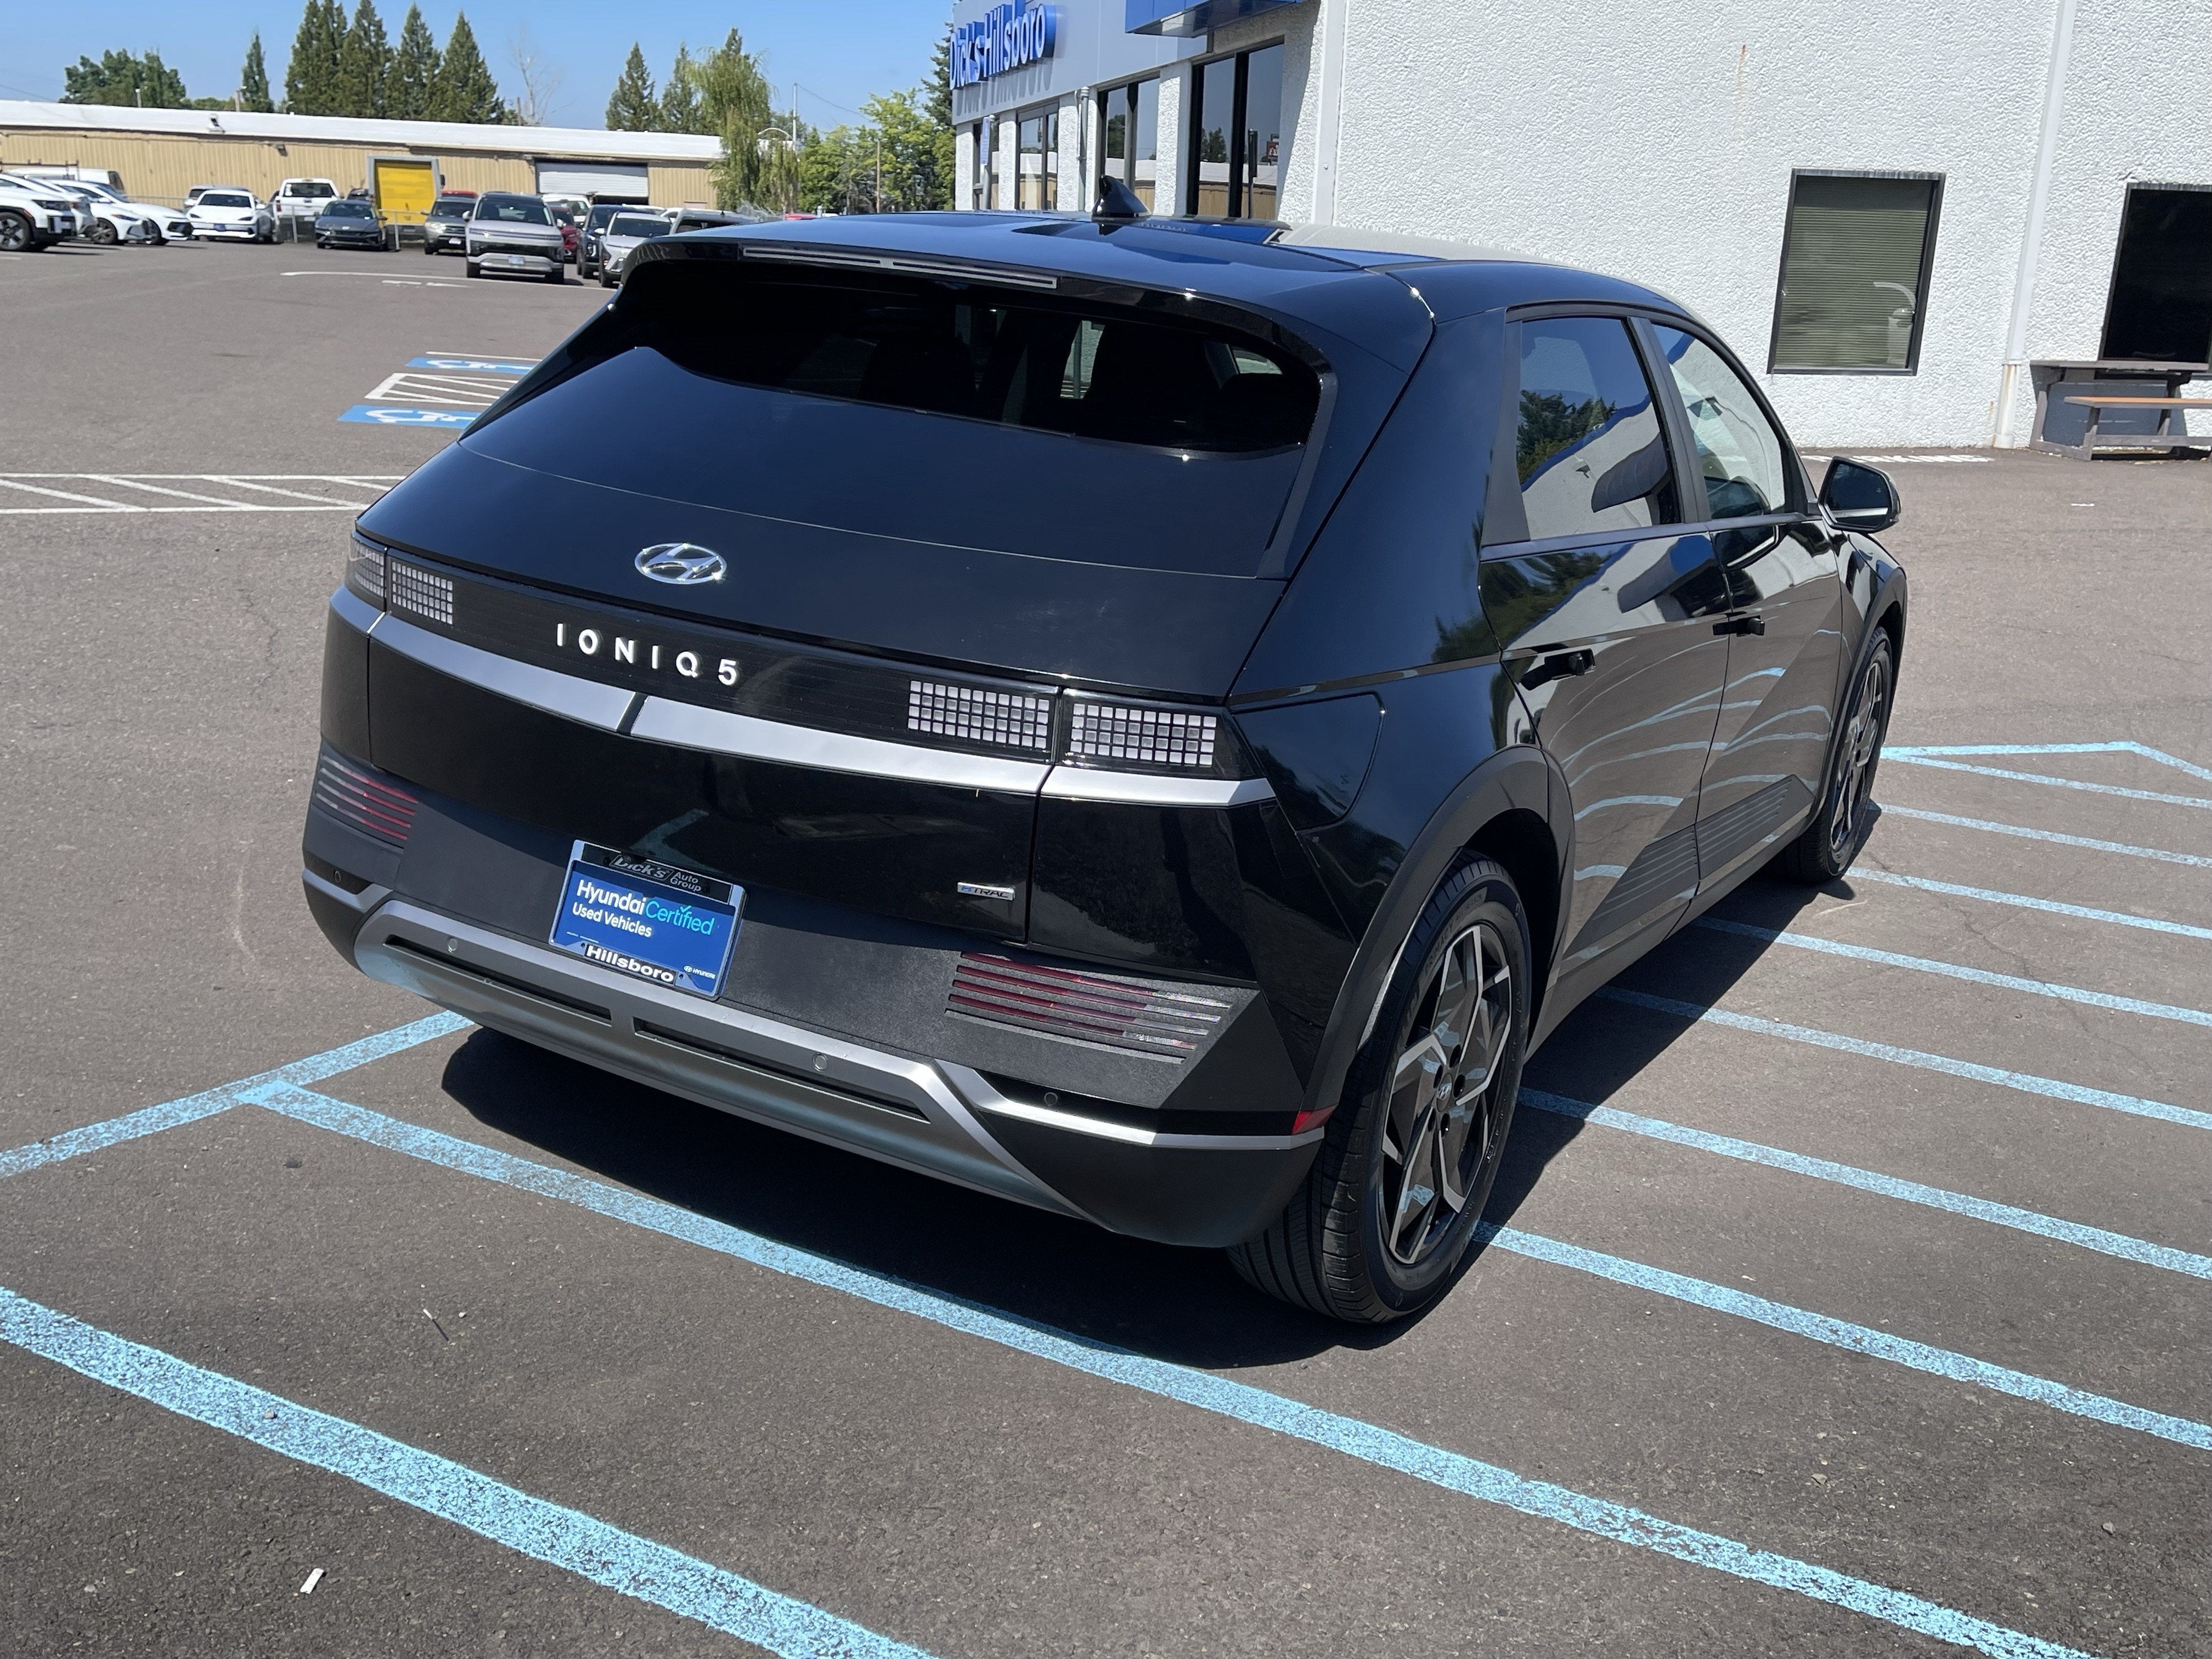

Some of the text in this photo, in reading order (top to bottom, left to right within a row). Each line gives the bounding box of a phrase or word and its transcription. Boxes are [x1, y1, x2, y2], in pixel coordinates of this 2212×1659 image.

[950, 0, 1046, 90] Dick's Hillsboro
[557, 623, 738, 686] IONIQ 5
[670, 878, 702, 893] Group
[673, 872, 699, 884] Auto
[572, 901, 603, 923] Used
[604, 910, 652, 938] Vehicles
[586, 944, 674, 983] Hillsboro
